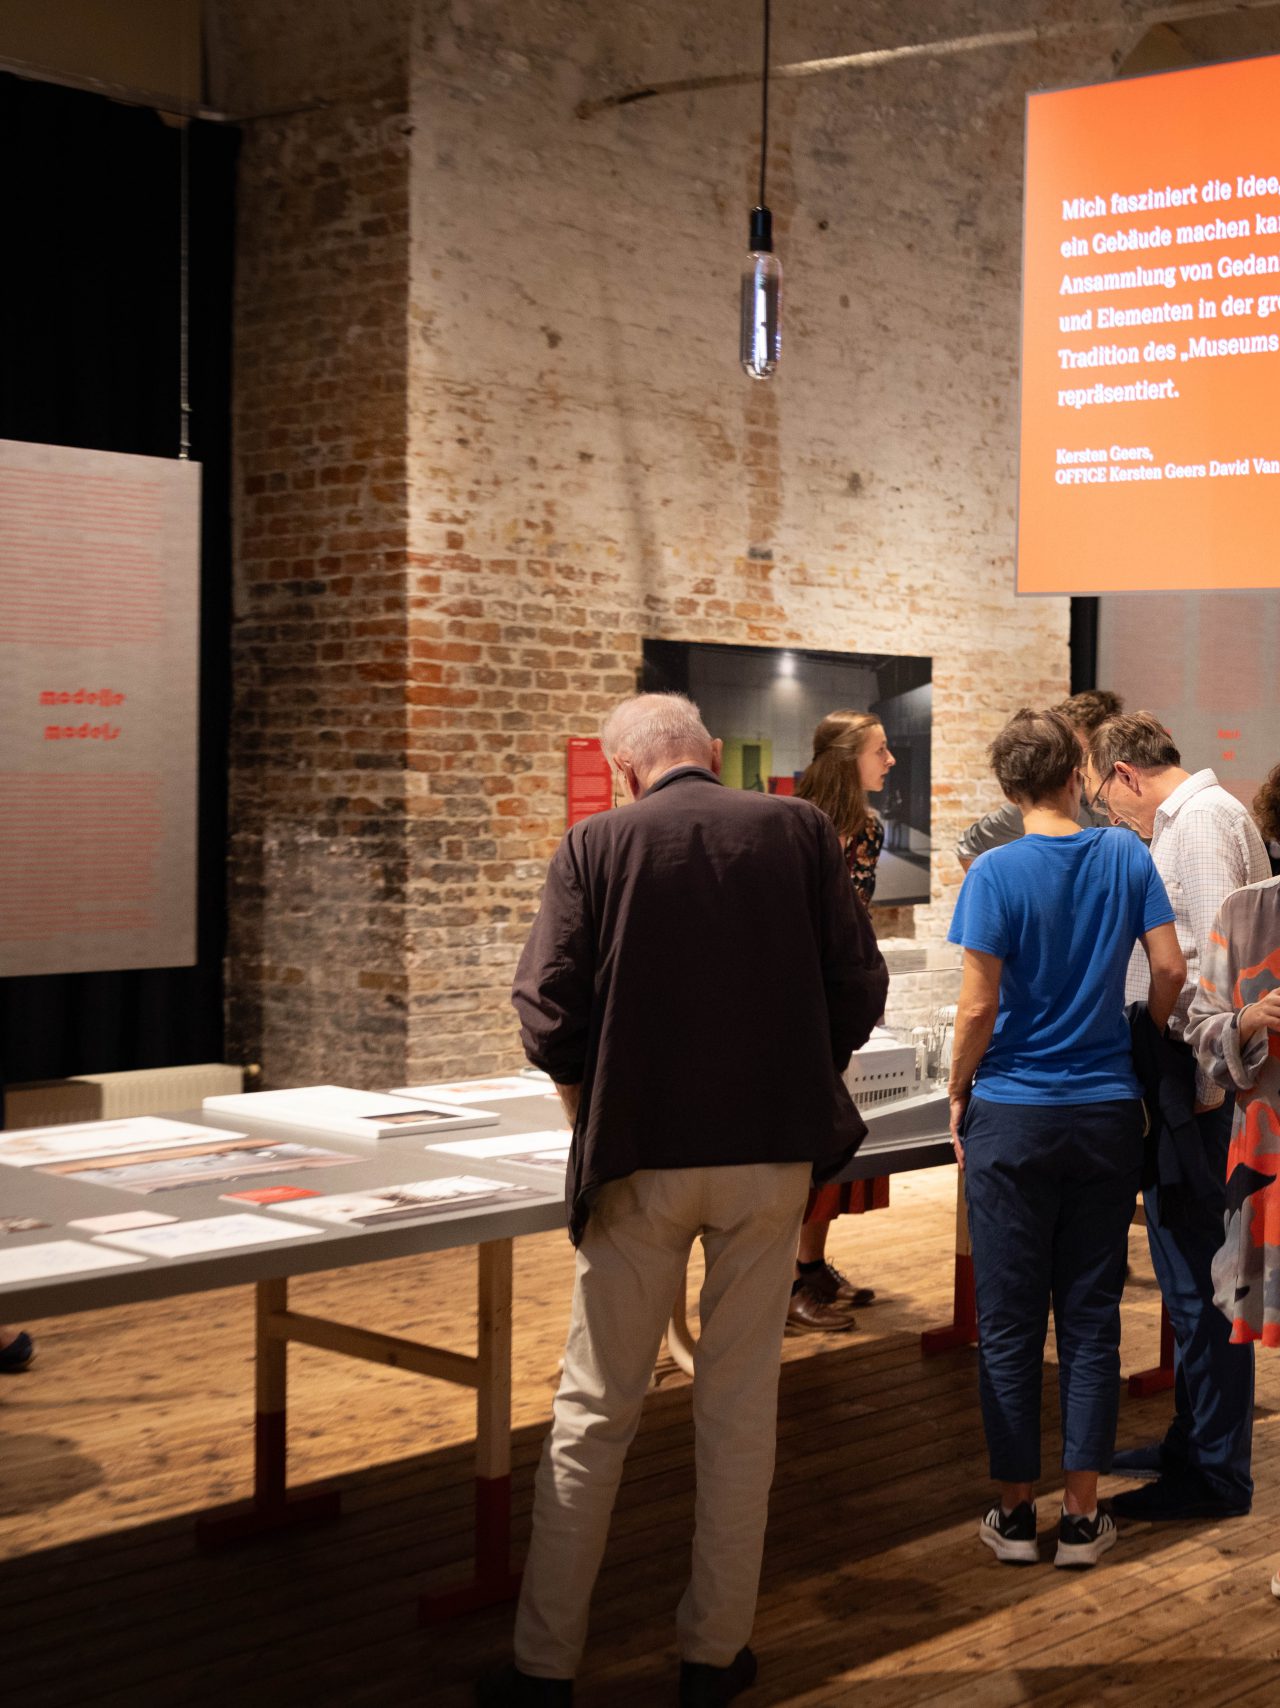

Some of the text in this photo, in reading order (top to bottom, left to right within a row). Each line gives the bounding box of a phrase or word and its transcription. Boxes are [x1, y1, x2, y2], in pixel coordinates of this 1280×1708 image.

[1061, 194, 1107, 221] Mich
[1109, 182, 1199, 215] fasziniert
[1200, 178, 1233, 203] die
[1059, 235, 1089, 259] ein
[1091, 225, 1173, 255] Gebäude
[1175, 217, 1251, 245] machen
[1058, 265, 1177, 296] Ansammlung
[1178, 262, 1214, 283] von
[1058, 309, 1093, 333] und
[1097, 302, 1194, 329] Elementen
[1197, 297, 1218, 319] in
[1220, 294, 1255, 318] der
[1057, 344, 1140, 370] Tradition
[1142, 340, 1177, 363] des
[1057, 377, 1181, 410] repräsentiert.
[1054, 466, 1108, 485] OFFICE
[1108, 465, 1163, 483] Kersten
[1163, 462, 1208, 480] Geers
[1208, 457, 1251, 478] David
[1251, 456, 1280, 475] Van
[1055, 444, 1154, 465] Kersten Geers,
